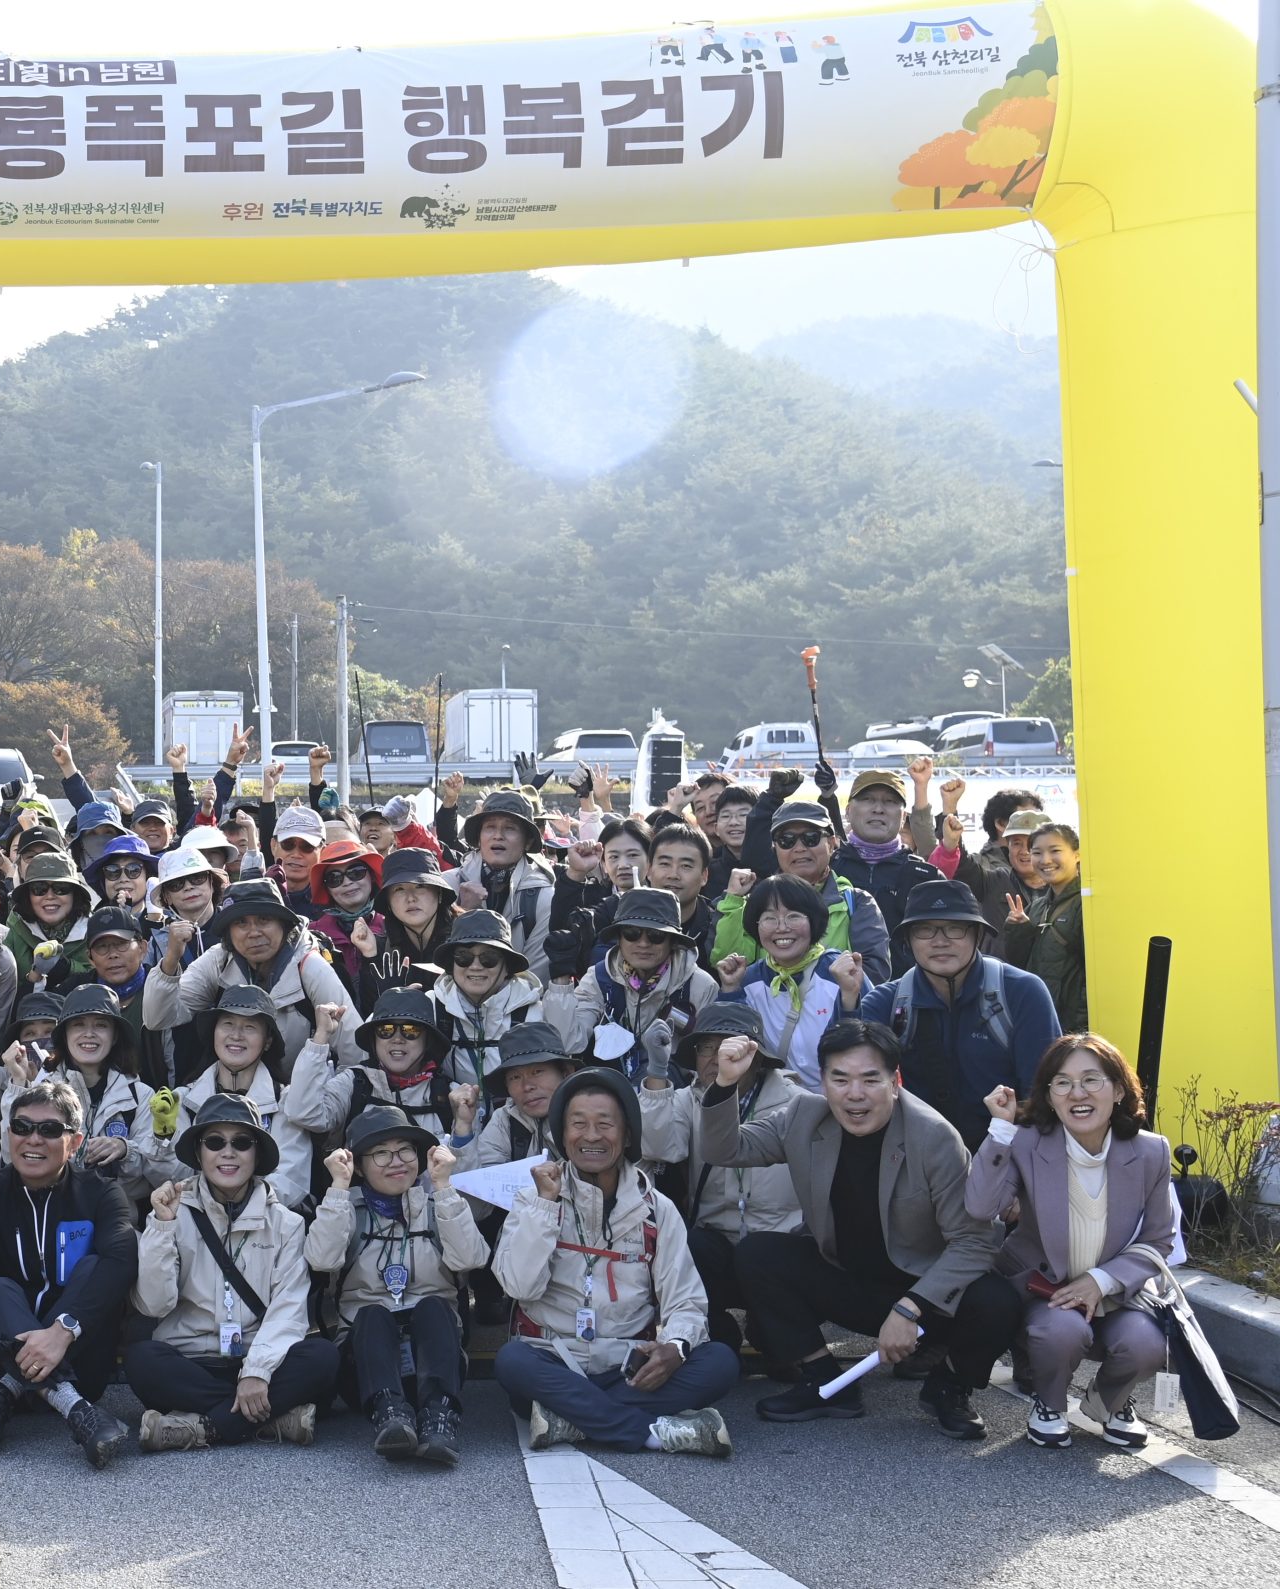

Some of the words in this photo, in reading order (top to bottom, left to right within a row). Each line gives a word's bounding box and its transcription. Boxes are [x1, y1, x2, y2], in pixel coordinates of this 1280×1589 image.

[896, 50, 927, 68] 전북
[932, 46, 1001, 66] 삼천리길
[59, 63, 90, 82] in
[100, 62, 165, 82] 남원
[401, 71, 784, 174] 행복걷기
[22, 202, 165, 215] 전북생태관광육성지원센터
[222, 202, 264, 221] 후원
[272, 198, 383, 218] 전북특별자치도
